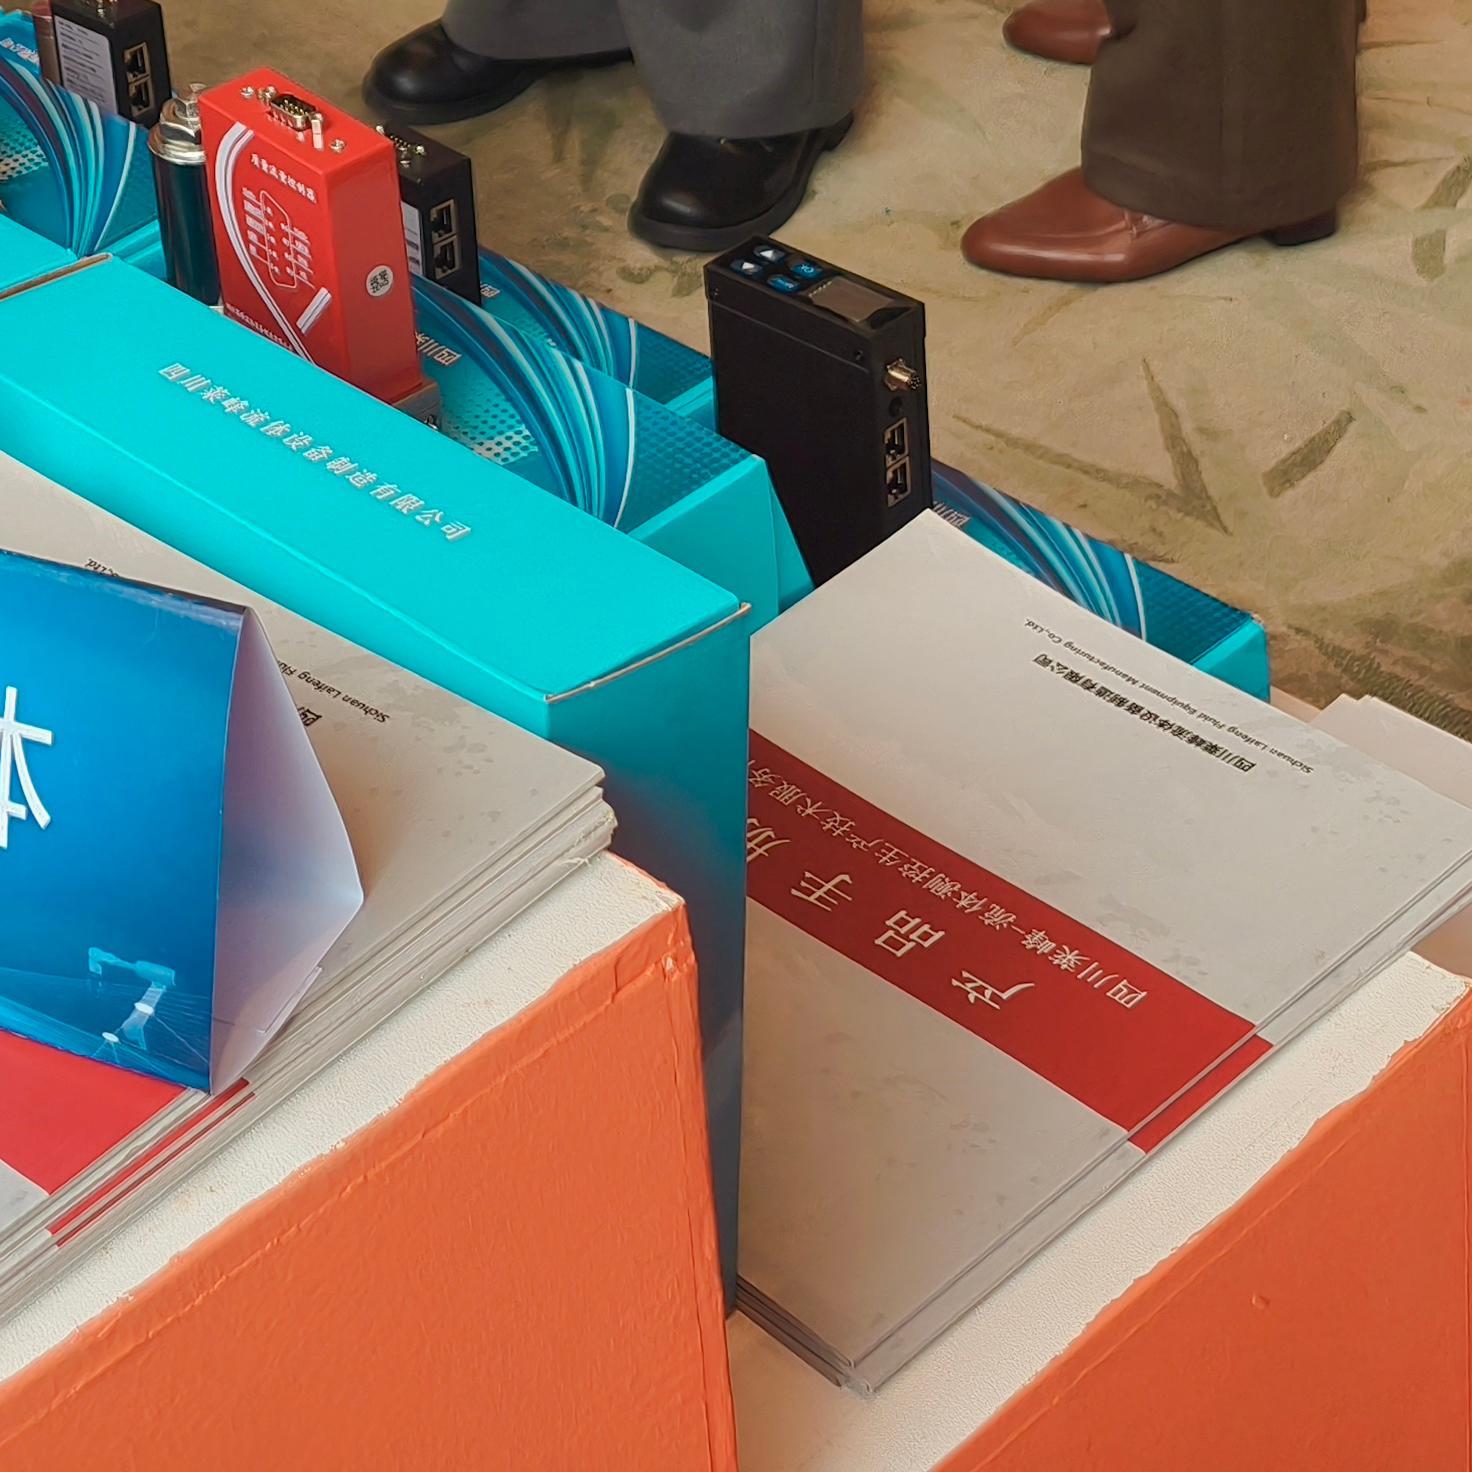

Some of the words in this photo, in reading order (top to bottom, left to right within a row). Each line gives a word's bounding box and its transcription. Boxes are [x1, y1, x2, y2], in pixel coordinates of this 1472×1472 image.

[158, 361, 471, 544] 四川莱峰流体设备制造有限公司
[1061, 638, 1140, 687] Manufacturing
[295, 667, 343, 701] Laifeng
[1138, 680, 1199, 717] Equipment
[339, 691, 391, 726] Sichuan
[1031, 648, 1257, 776] 四川莱峰流体设备制造有限公司
[1197, 711, 1226, 730] Fluid
[1225, 723, 1268, 752] Laifeng
[1268, 746, 1315, 775] Sichuan
